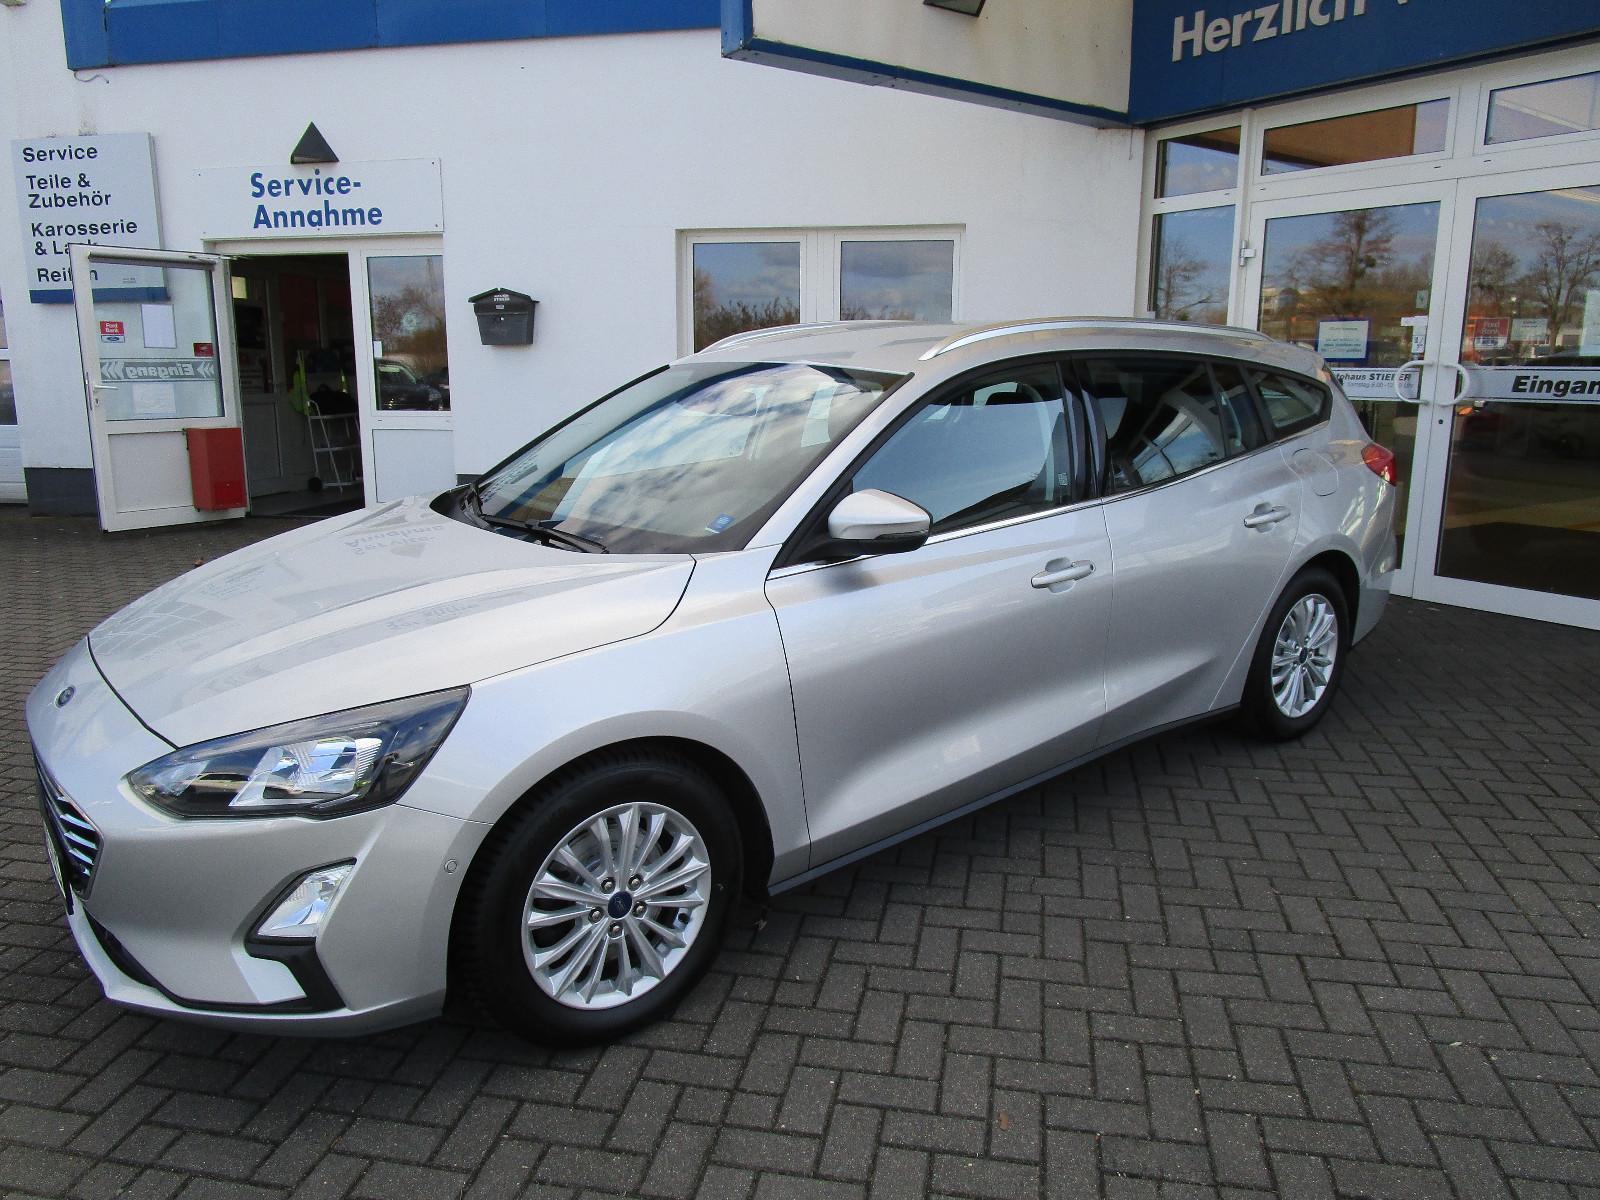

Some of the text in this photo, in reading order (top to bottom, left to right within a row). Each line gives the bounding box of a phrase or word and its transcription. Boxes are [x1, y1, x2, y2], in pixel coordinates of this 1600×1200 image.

[22, 145, 98, 163] Service
[26, 173, 91, 190] Teile &
[250, 168, 361, 198] Service-
[28, 190, 112, 209] Zubehör
[253, 200, 383, 229] Annahme
[31, 219, 138, 237] Karosserie
[34, 241, 47, 256] &
[37, 268, 98, 282] Reifn
